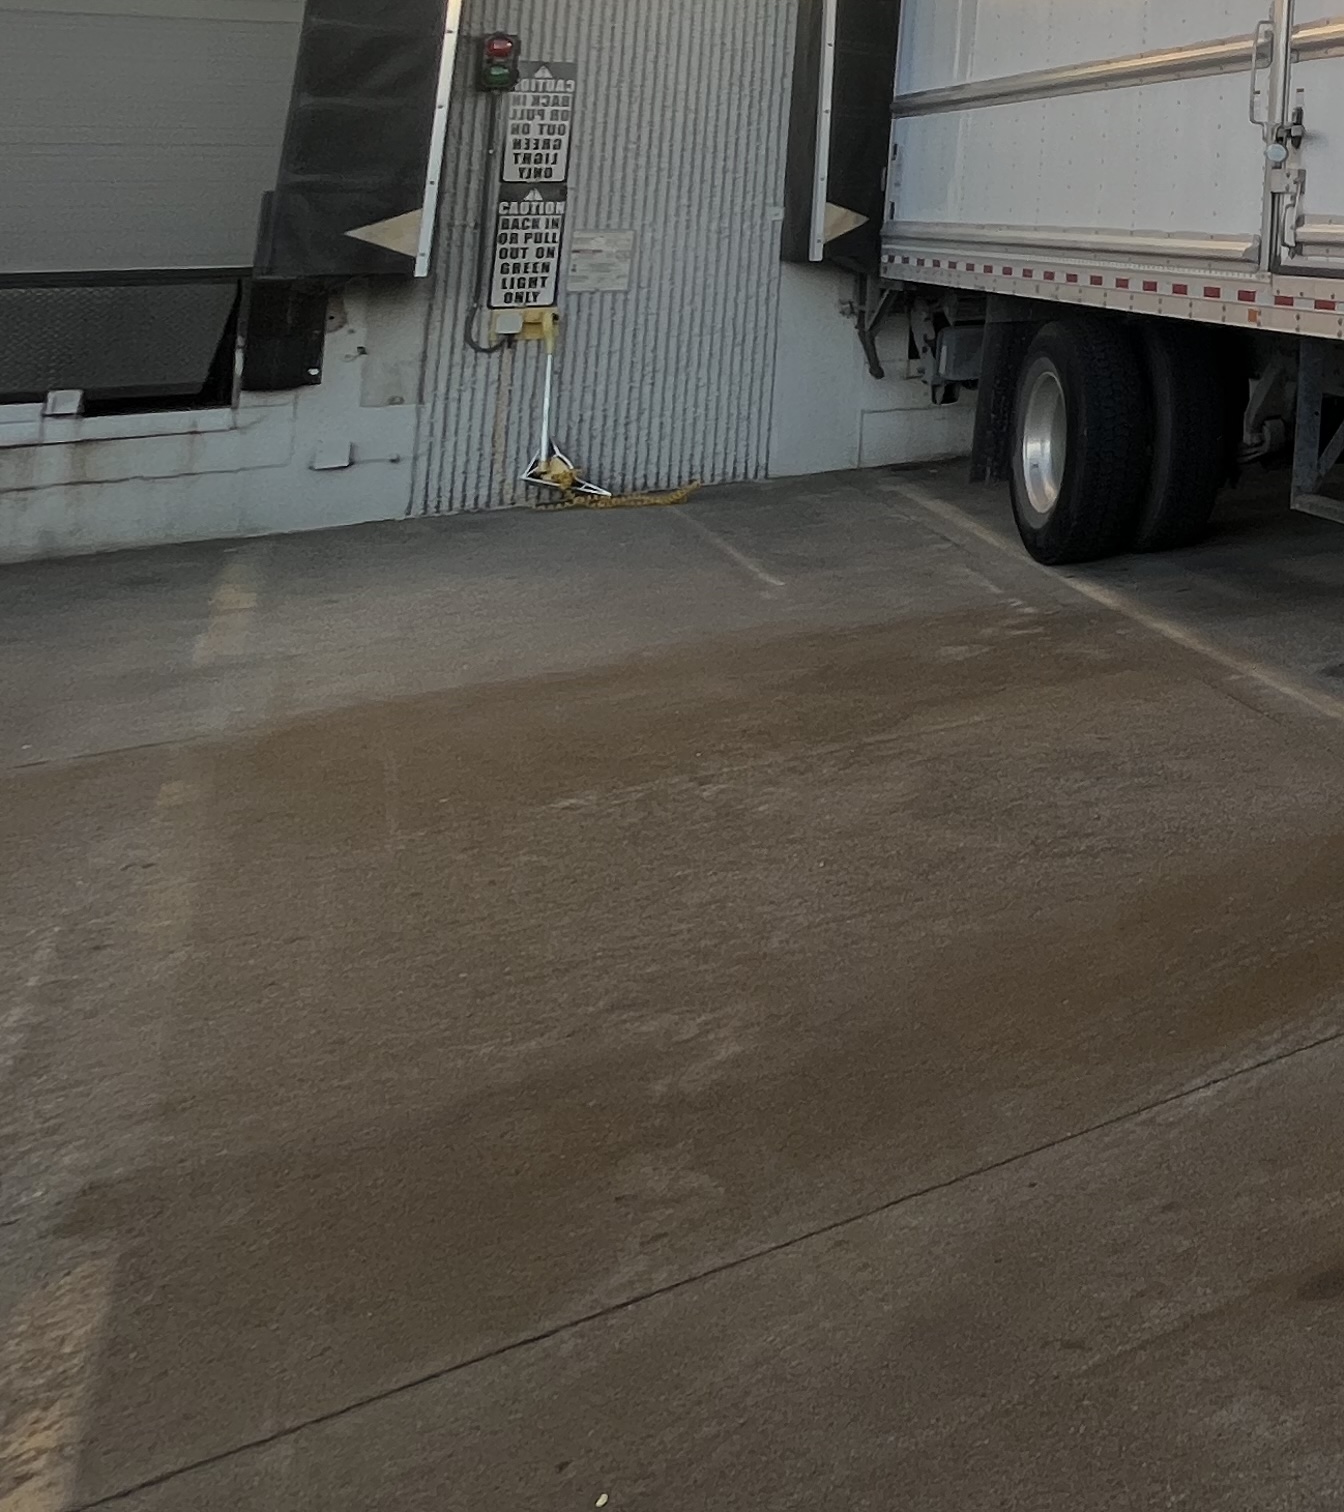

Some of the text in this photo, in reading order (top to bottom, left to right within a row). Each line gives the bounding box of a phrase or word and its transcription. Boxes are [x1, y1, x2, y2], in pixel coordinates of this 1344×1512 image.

[499, 201, 565, 215] CAUTION
[501, 217, 559, 230] BACK IN
[498, 232, 558, 245] OR PULL
[499, 246, 555, 259] OUT ON
[500, 261, 550, 275] GREEN
[501, 276, 549, 290] LIGHT
[503, 291, 540, 304] ONLY
